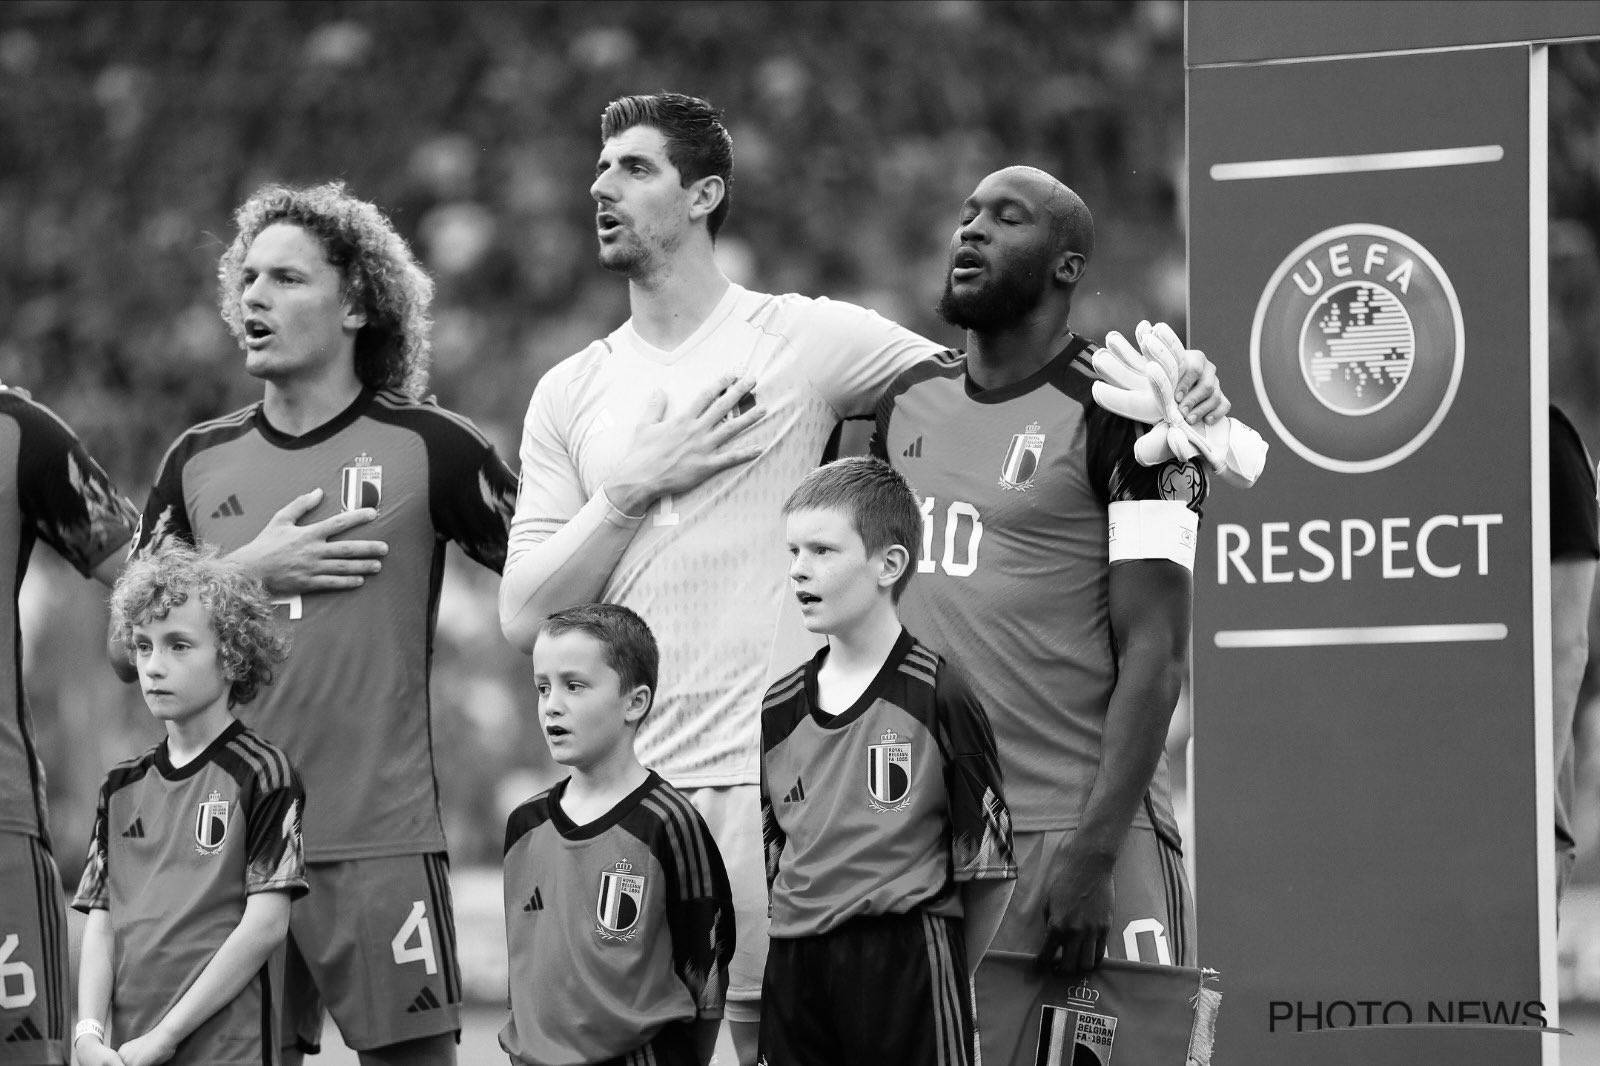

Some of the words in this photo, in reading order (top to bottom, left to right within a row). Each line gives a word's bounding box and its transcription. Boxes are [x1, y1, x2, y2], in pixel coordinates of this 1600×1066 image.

[1292, 242, 1414, 296] UEFA
[916, 495, 984, 577] 10
[1216, 513, 1504, 585] RESPECT
[391, 899, 438, 976] 4
[1077, 1023, 1113, 1037] BELGIAN
[1079, 1014, 1107, 1028] ROYAL
